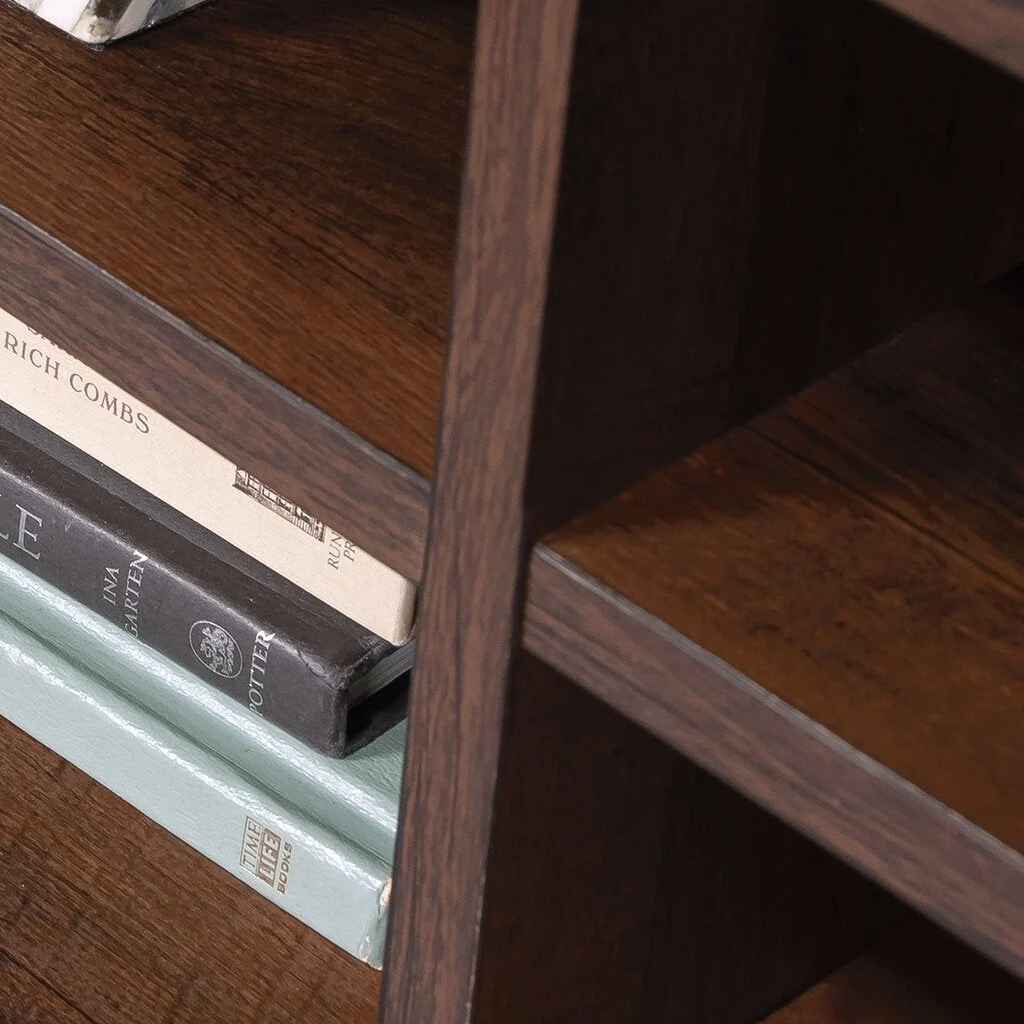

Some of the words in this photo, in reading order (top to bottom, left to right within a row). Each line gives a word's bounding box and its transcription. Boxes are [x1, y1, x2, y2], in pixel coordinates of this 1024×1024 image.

[3, 330, 61, 381] RICH
[69, 372, 150, 434] COMBS
[102, 566, 120, 607] INA
[248, 629, 276, 718] POTTER
[242, 820, 262, 869] TIME
[259, 834, 280, 880] LIFE
[276, 841, 293, 895] BOOKS
